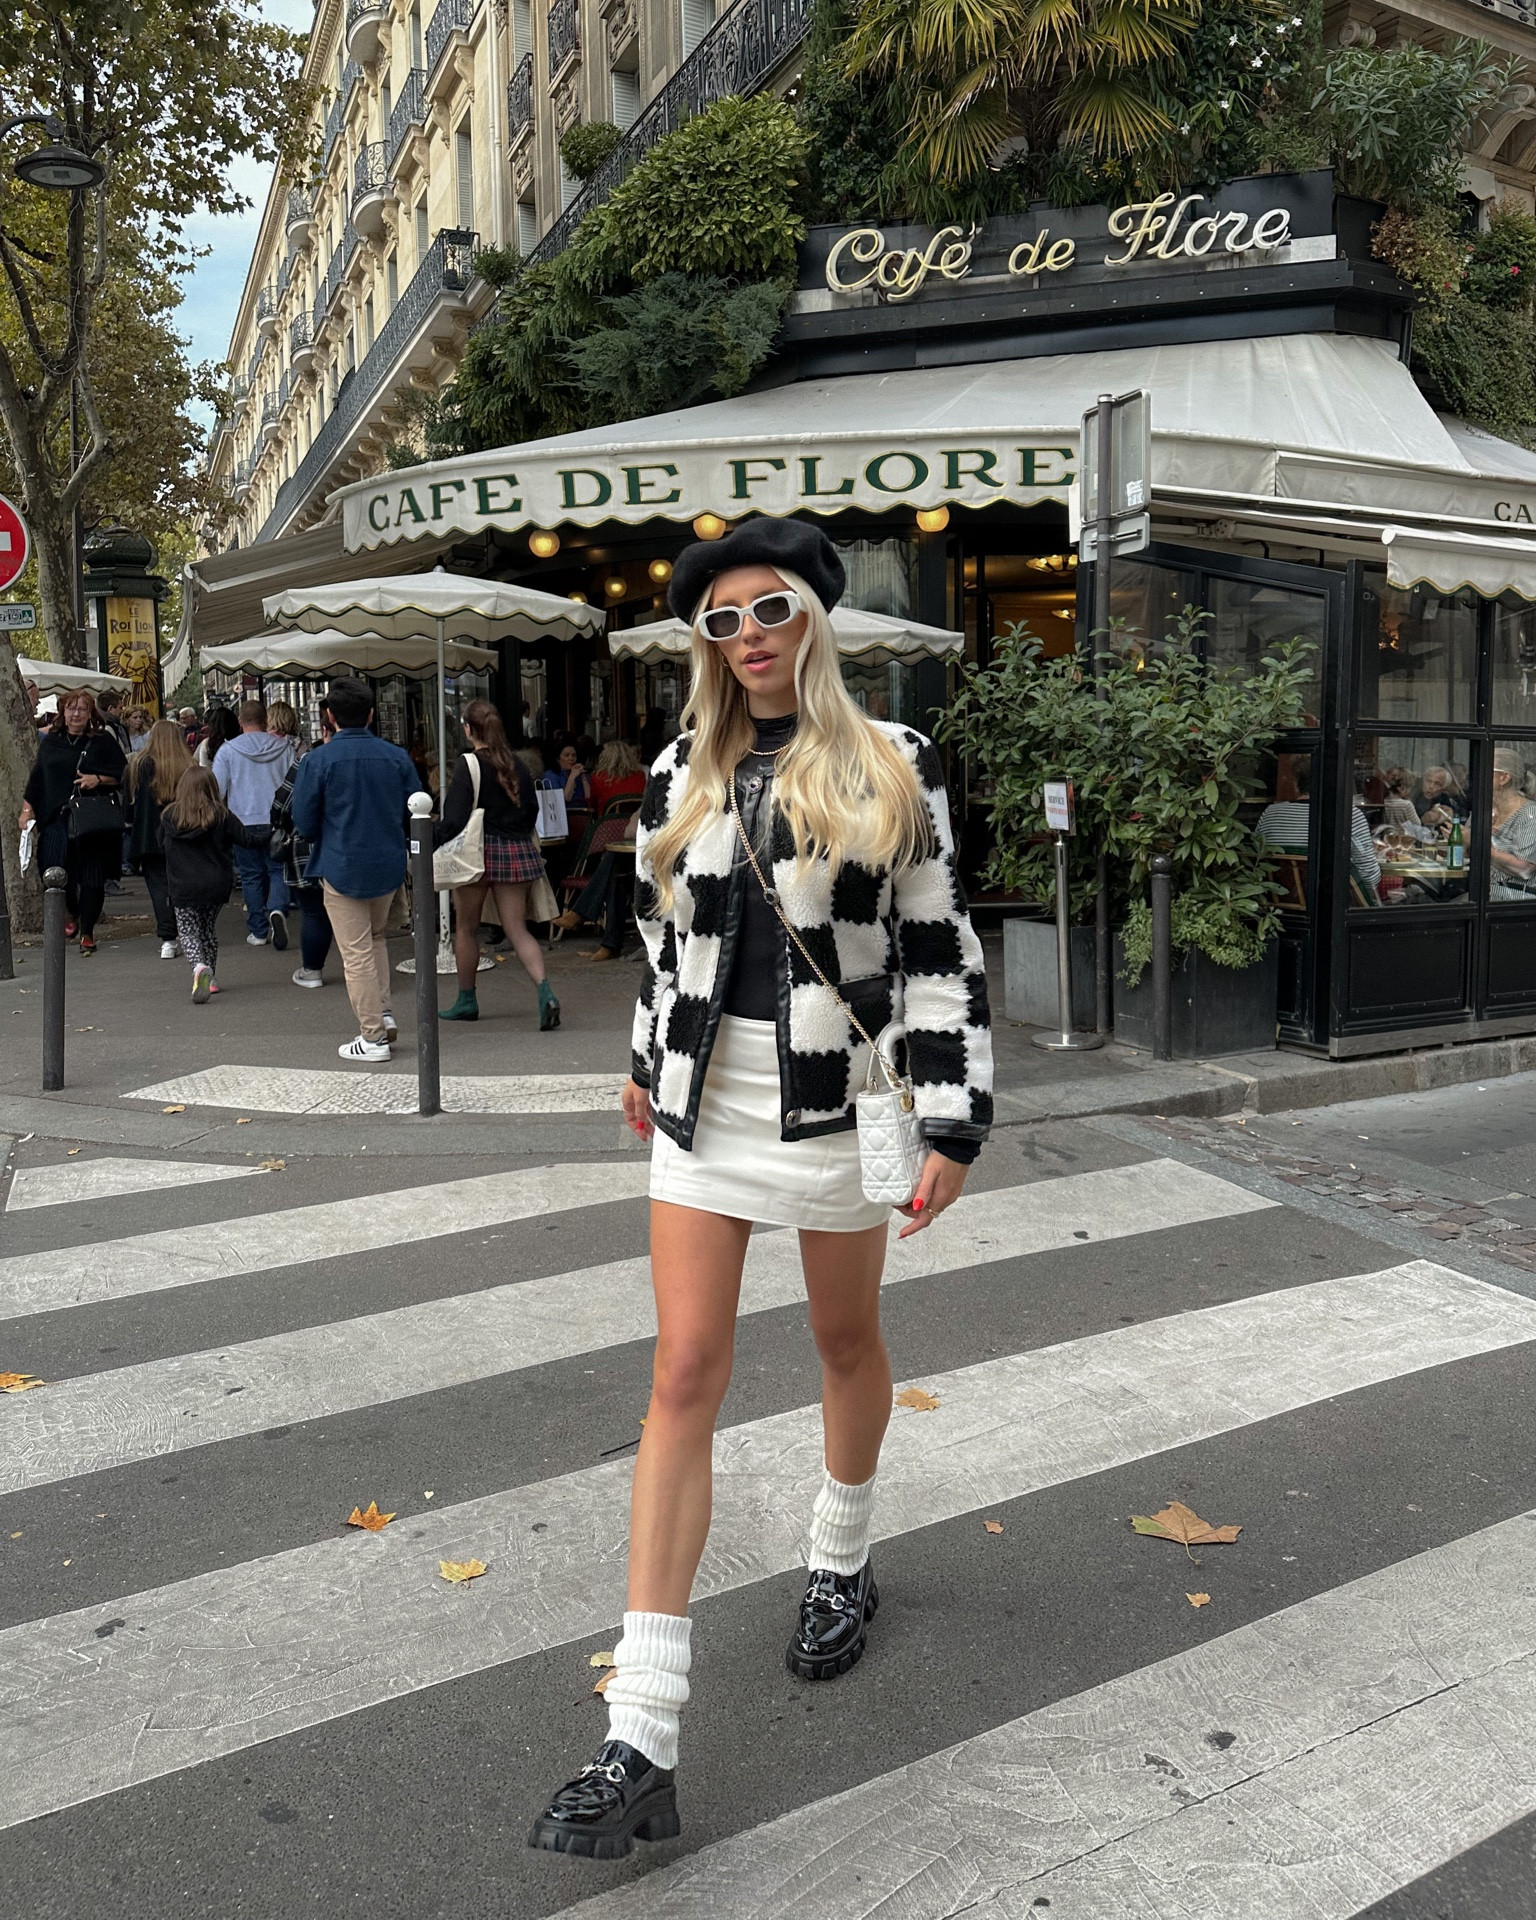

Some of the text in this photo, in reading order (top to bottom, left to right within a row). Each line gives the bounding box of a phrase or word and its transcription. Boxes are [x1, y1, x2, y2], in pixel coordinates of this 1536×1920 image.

[826, 192, 1291, 302] Café de Flore
[367, 473, 523, 532] CAFE
[557, 462, 682, 510] DE
[724, 447, 1077, 500] FLORE
[129, 606, 139, 616] LE
